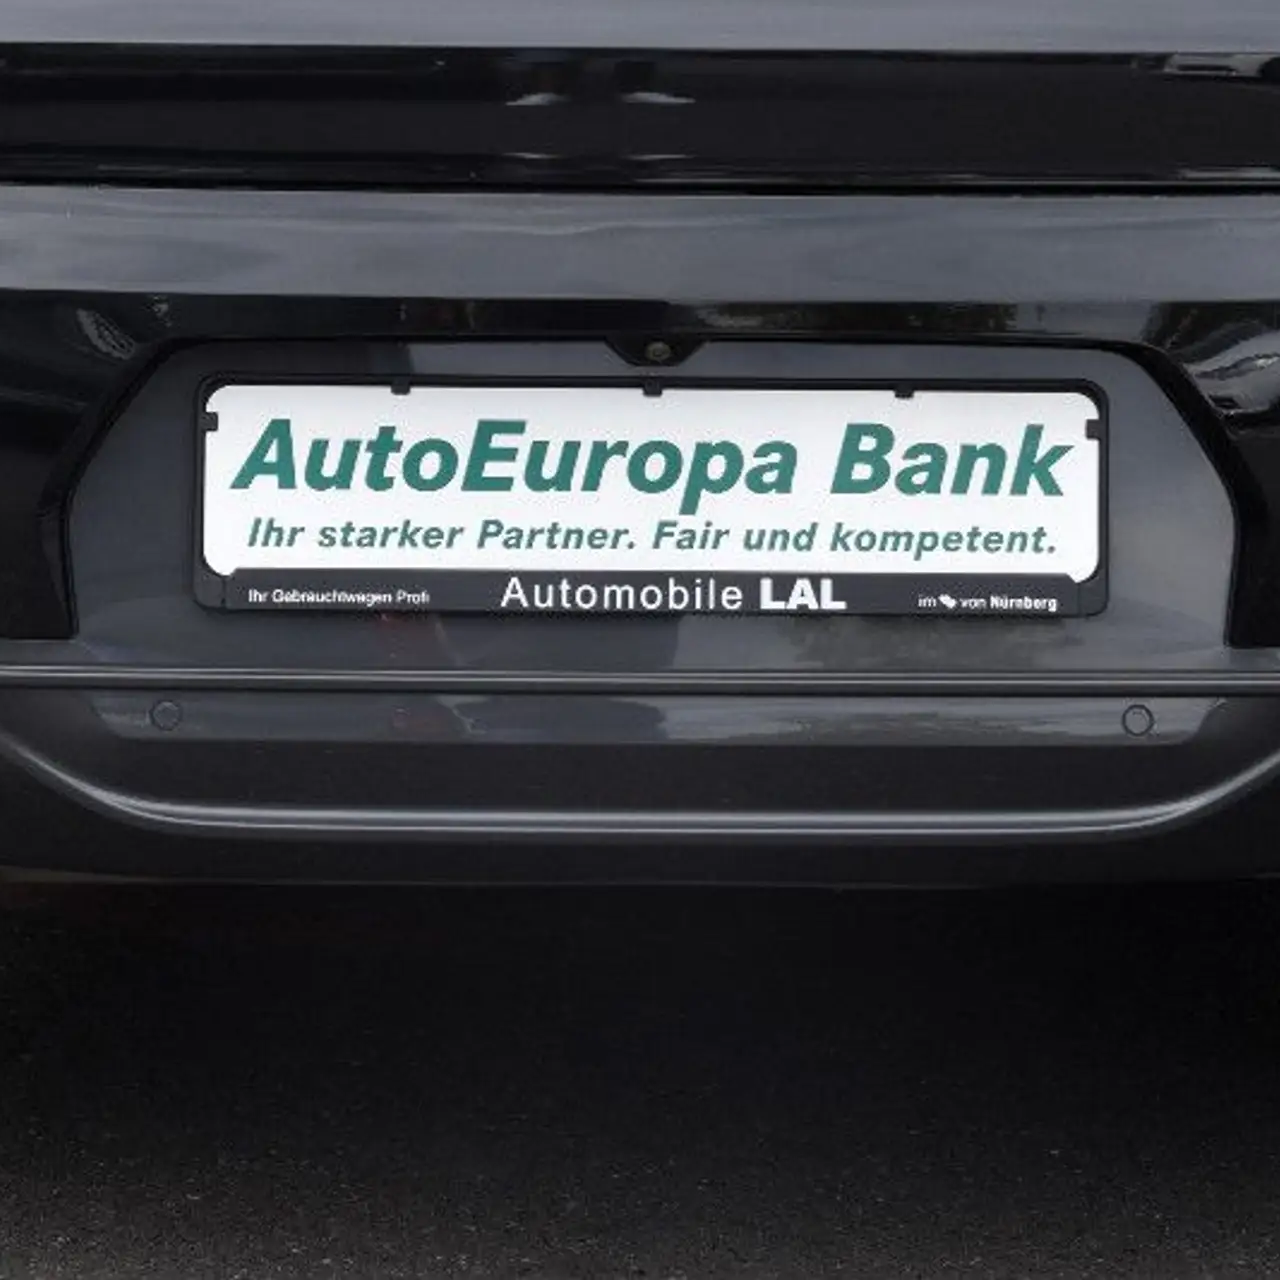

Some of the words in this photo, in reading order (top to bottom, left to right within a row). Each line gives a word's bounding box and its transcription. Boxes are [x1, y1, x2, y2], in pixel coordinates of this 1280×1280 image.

[230, 418, 798, 515] AutoEuropa
[831, 423, 1075, 497] Bank
[247, 517, 305, 549] Ihr
[318, 518, 464, 549] starker
[476, 519, 636, 550] Partner.
[652, 521, 729, 551] Fair
[742, 523, 819, 552] und
[829, 523, 1056, 560] kompetent.
[247, 588, 268, 603] Ihr
[272, 588, 393, 607] Gebrauchtwagen
[396, 588, 430, 604] Profi
[500, 576, 744, 610] Automobile
[759, 578, 848, 611] LAL
[918, 593, 937, 608] im
[959, 597, 987, 609] von
[989, 593, 1058, 613] Nürnberg
